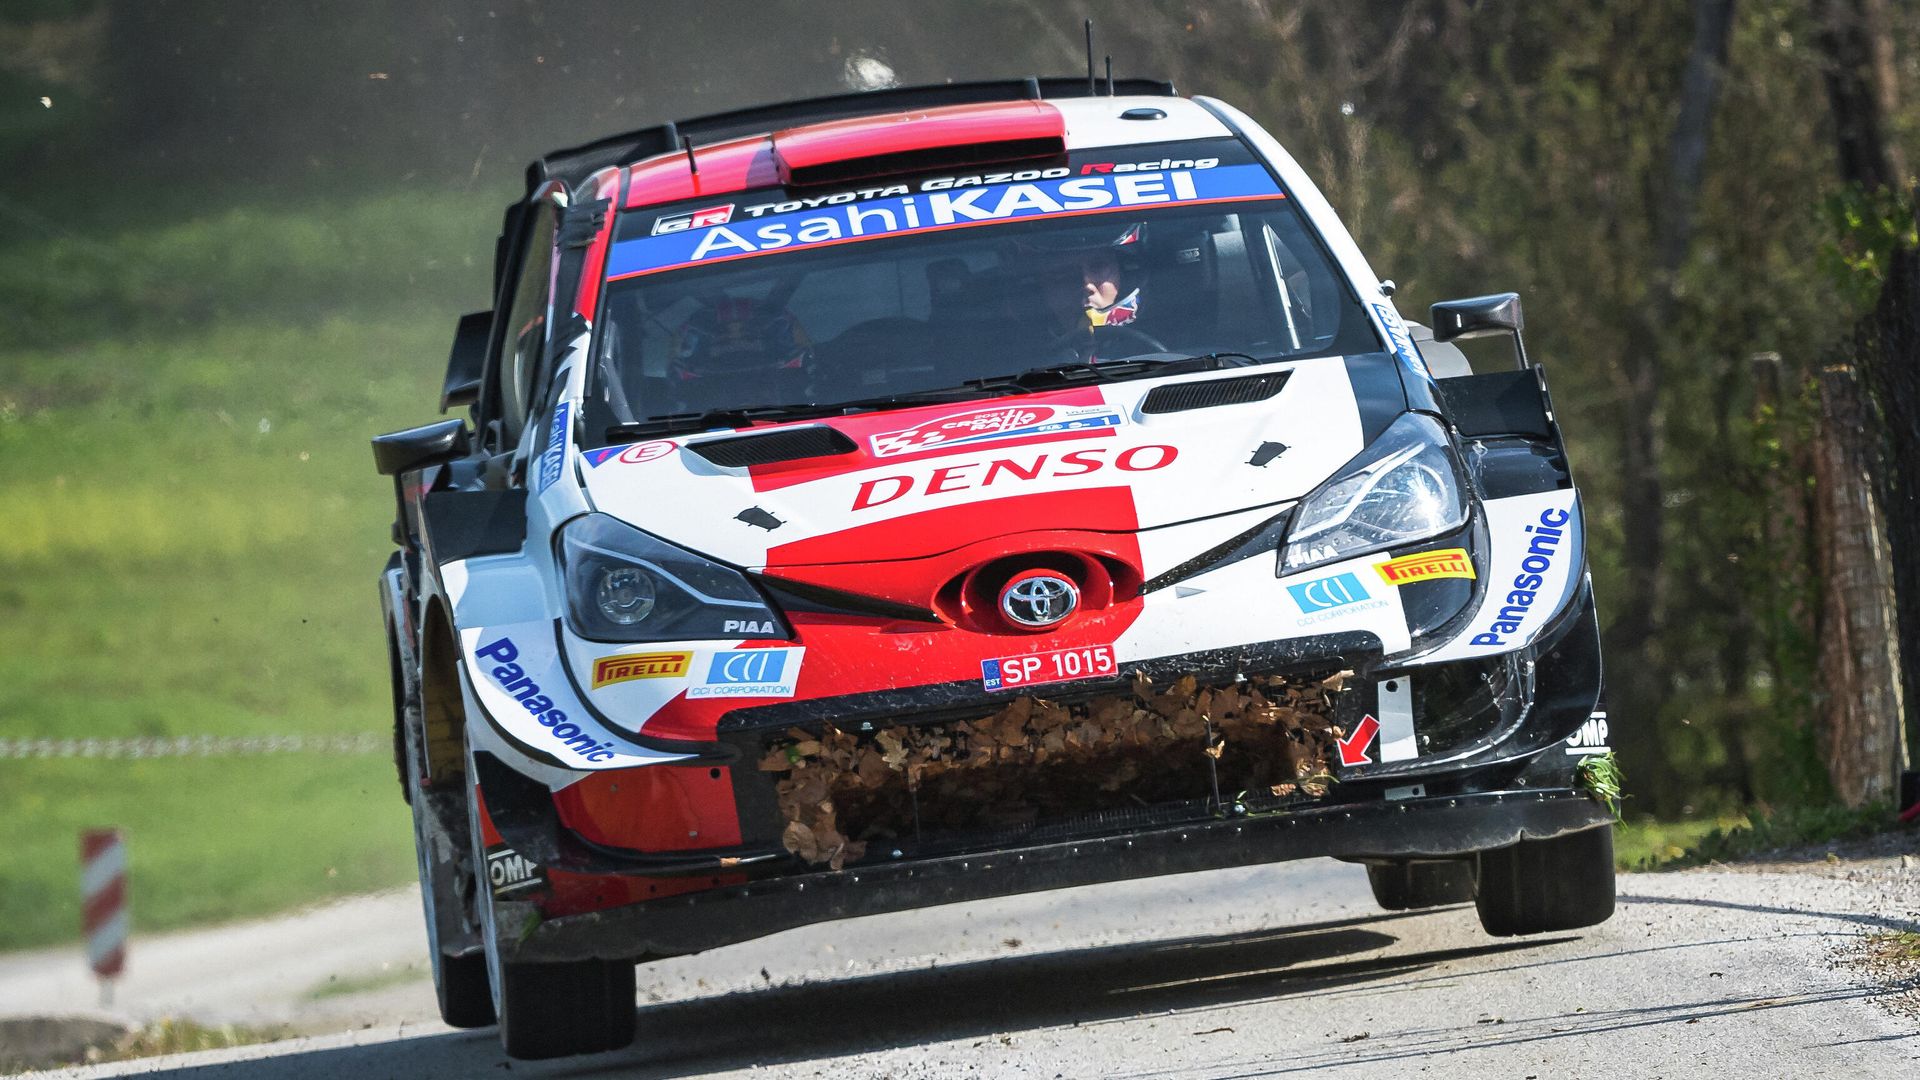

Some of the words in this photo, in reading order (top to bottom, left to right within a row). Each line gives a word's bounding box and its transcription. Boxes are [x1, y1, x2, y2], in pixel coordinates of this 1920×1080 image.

[745, 184, 909, 217] TOYOTA
[920, 167, 1070, 191] GAZOO
[1080, 157, 1219, 176] Racing
[1101, 416, 1111, 425] 1
[851, 444, 1178, 511] DENSO
[1381, 553, 1467, 581] PIRELLI
[1469, 508, 1569, 645] Panasonic
[1320, 600, 1389, 621] CORPORATION
[723, 620, 775, 634] PIAA
[597, 655, 686, 683] PIRELLI
[1003, 657, 1041, 683] SP
[1052, 648, 1111, 676] 1015
[692, 687, 710, 695] CCI
[714, 685, 790, 695] CORPORATION
[986, 678, 1000, 687] EST
[475, 637, 614, 762] Panasonic
